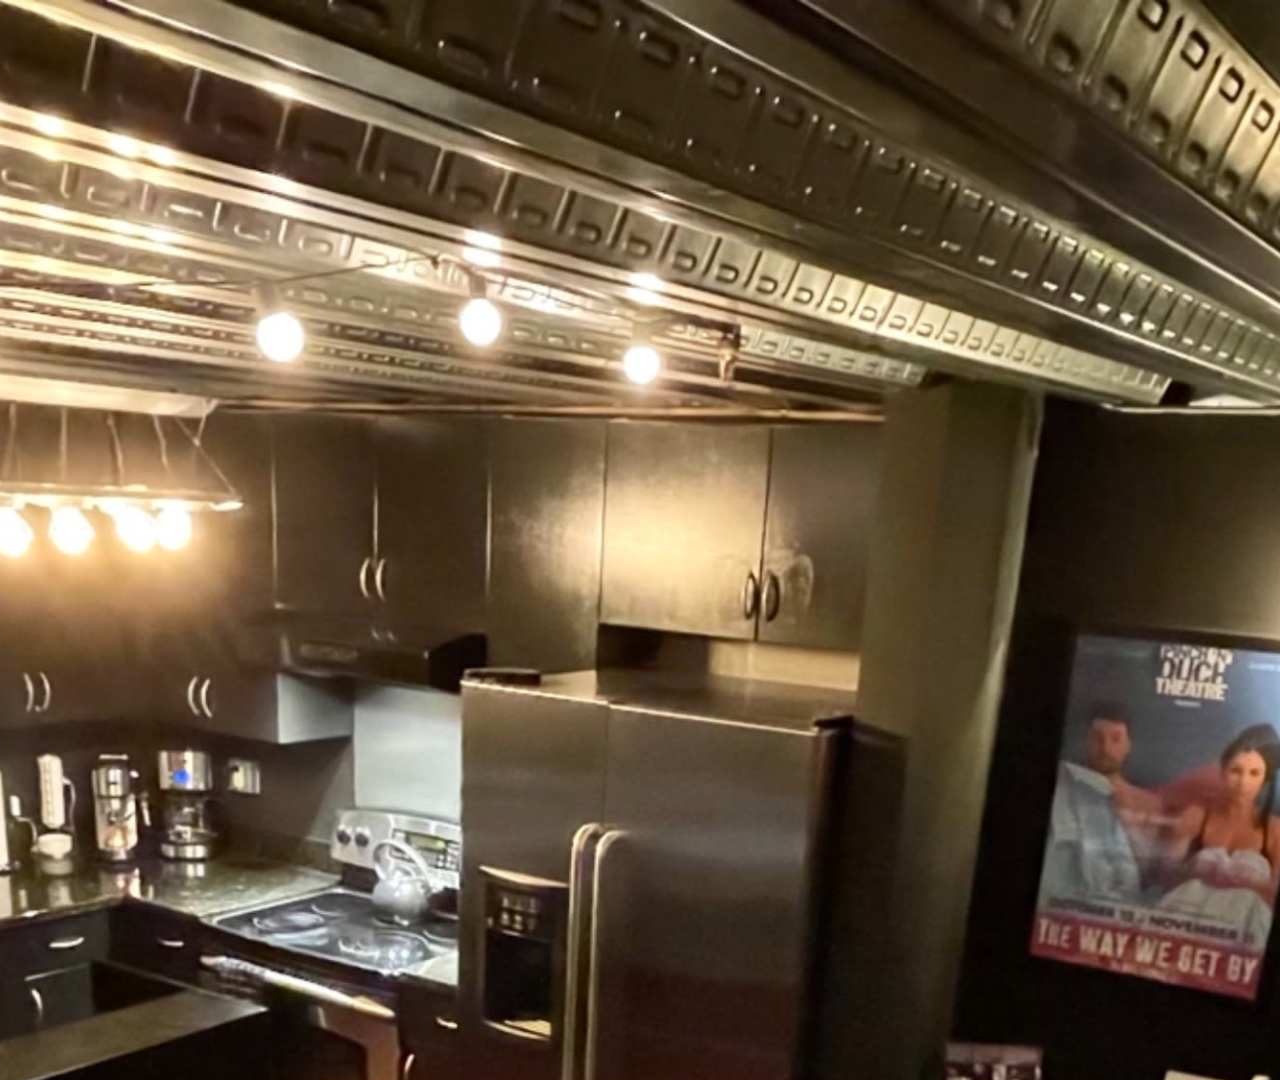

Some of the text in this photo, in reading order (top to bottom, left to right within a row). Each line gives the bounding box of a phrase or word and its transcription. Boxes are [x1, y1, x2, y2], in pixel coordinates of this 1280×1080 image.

[1155, 677, 1229, 700] THEATRE
[1038, 919, 1073, 947] THE
[1079, 925, 1129, 958] WAY
[1134, 936, 1172, 967] WE
[1177, 946, 1221, 978] GET
[1227, 955, 1259, 984] BY
